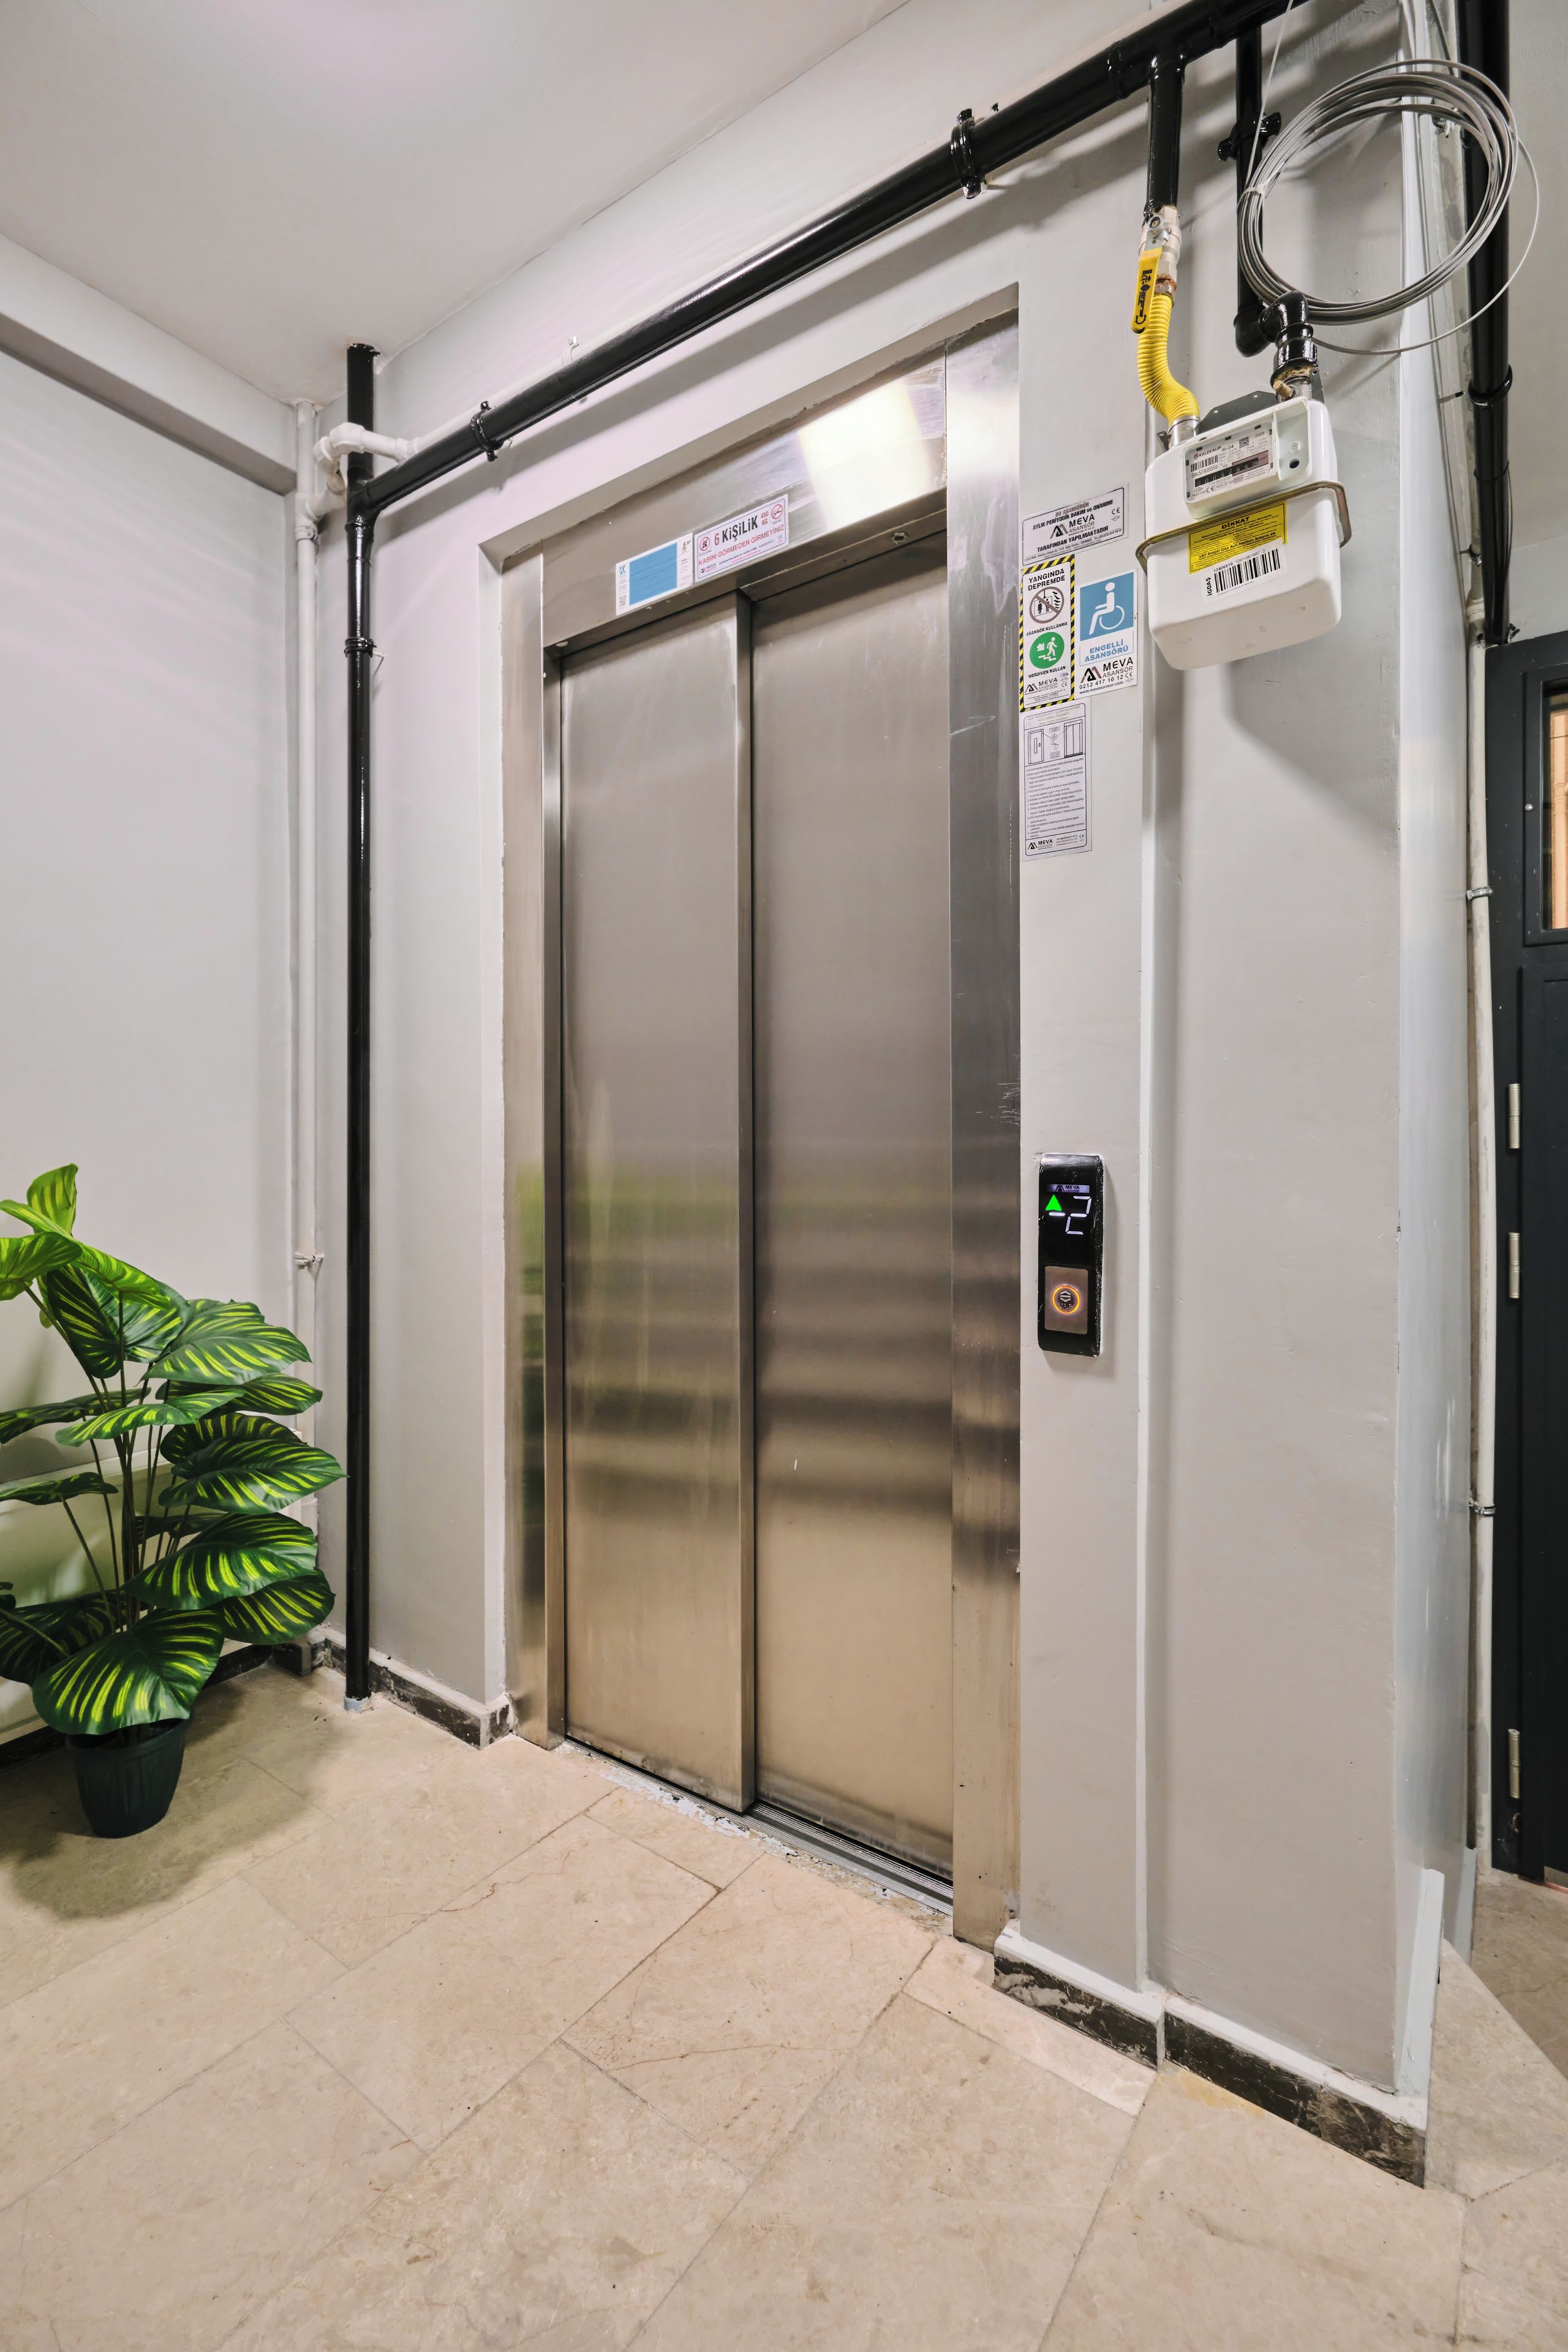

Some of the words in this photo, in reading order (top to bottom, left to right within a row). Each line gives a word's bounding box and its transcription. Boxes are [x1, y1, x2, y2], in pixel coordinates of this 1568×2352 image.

[1071, 509, 1086, 518] BAKIM
[1093, 499, 1113, 511] ONARIMI
[1069, 514, 1095, 528] MEVA
[1069, 521, 1095, 533] ASANSÖR
[1221, 516, 1251, 530] DİKKAT
[714, 533, 720, 546] 6
[718, 538, 750, 557] GÖRMEDEN
[751, 524, 785, 543] GİRMEYİNİZ
[1037, 538, 1067, 552] TARAFINDAN
[1068, 526, 1109, 543] YAPILMAKTADIR
[1028, 568, 1065, 584] YANGINDA
[1028, 575, 1066, 591] DEPREMDE
[1026, 627, 1046, 636] ASANSÖR
[1046, 621, 1068, 632] KULLANMA
[1084, 644, 1129, 663] ASANSÖRÜ
[1089, 638, 1124, 654] ENGELLİ
[1028, 669, 1049, 679] MERDİVEN
[1049, 665, 1066, 674] KULLAN
[1102, 665, 1133, 678] ASANSÖR
[1103, 657, 1134, 672] MEVA
[1038, 677, 1058, 687] MEVA
